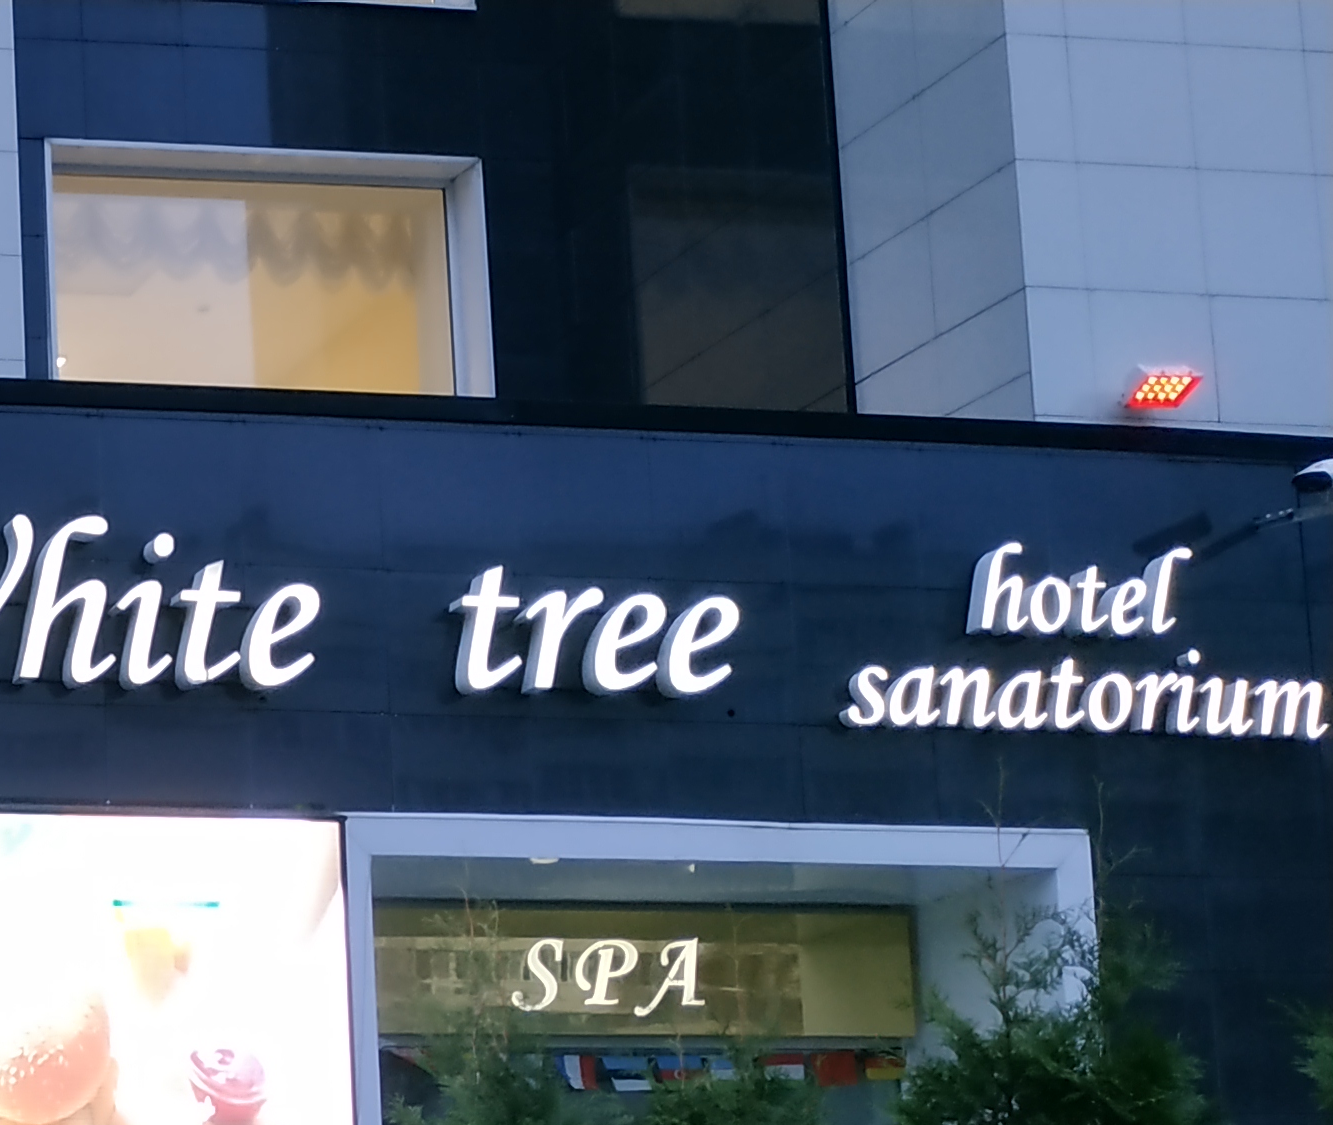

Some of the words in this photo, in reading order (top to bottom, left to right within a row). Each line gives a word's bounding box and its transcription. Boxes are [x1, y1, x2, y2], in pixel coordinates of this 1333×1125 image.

[449, 564, 742, 697] tree
[967, 540, 1194, 637] hotel
[841, 648, 1331, 741] sanatorium
[509, 936, 707, 1018] SPA
